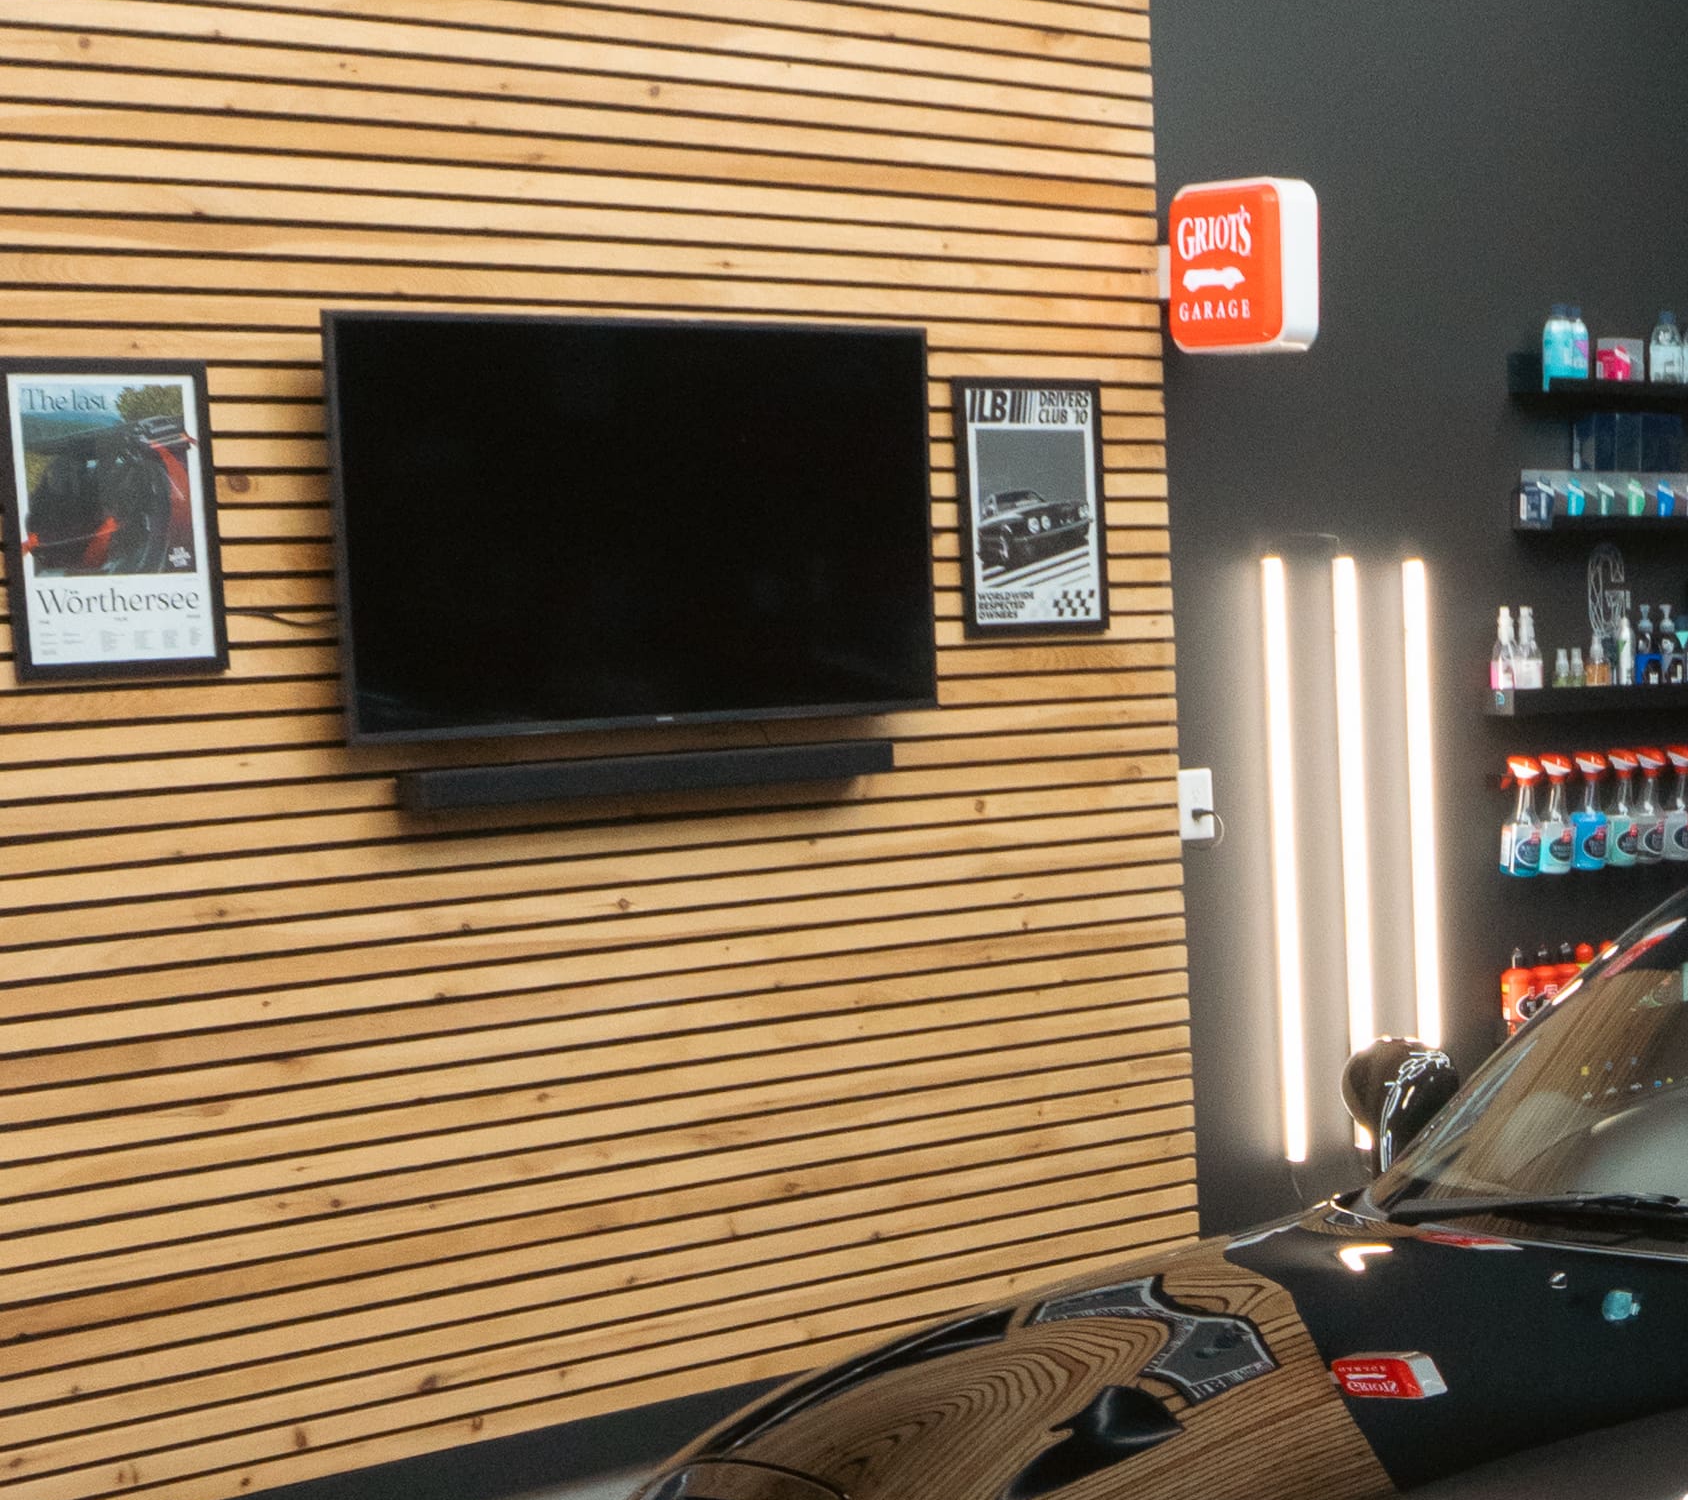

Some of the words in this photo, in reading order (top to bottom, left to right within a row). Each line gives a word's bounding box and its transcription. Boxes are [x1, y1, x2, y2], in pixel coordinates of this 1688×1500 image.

[1177, 204, 1252, 261] GRIOT'S
[1178, 299, 1250, 322] GARAGE
[21, 387, 68, 413] The
[71, 388, 107, 412] last
[1039, 390, 1089, 408] DRIVERS
[1037, 408, 1068, 424] CLUB
[36, 586, 200, 616] Wörthersee
[978, 610, 1018, 619] OWNERS
